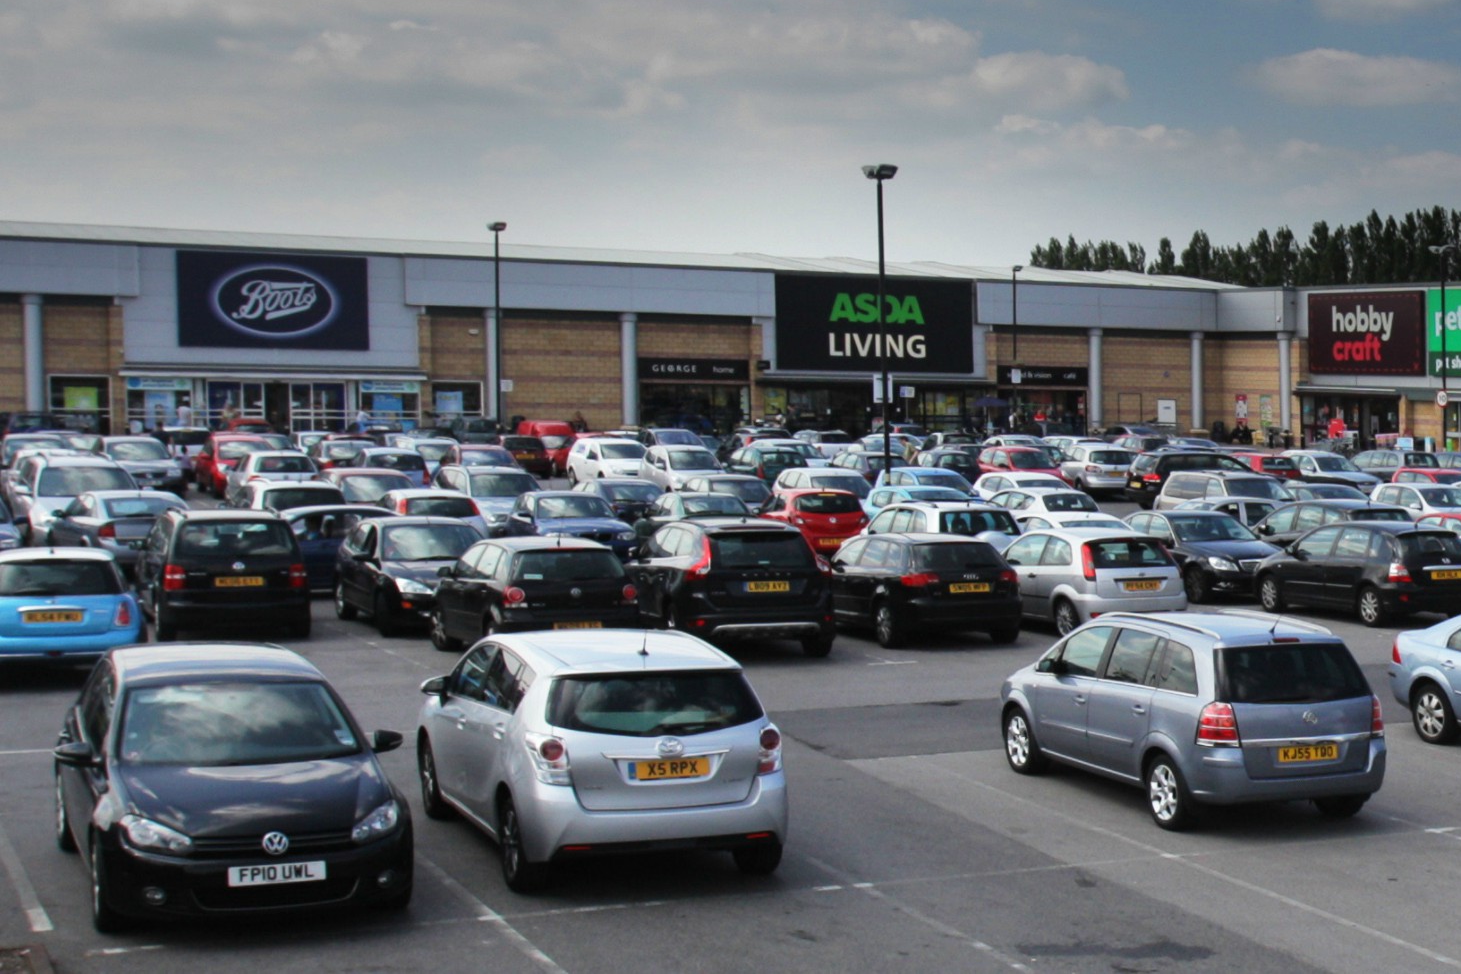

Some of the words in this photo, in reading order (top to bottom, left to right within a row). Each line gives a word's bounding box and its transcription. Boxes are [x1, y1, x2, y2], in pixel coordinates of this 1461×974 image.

[232, 280, 318, 320] Boots
[829, 293, 926, 325] ASDA
[1332, 305, 1394, 341] hobby
[829, 332, 927, 358] LIVING
[1333, 333, 1382, 361] craft
[652, 364, 697, 373] GEORGE
[1435, 358, 1449, 371] pt
[1283, 747, 1311, 760] KJ55
[648, 763, 666, 776] X5
[670, 761, 698, 774] RPX
[239, 866, 277, 882] FP10
[283, 864, 315, 878] UWL
